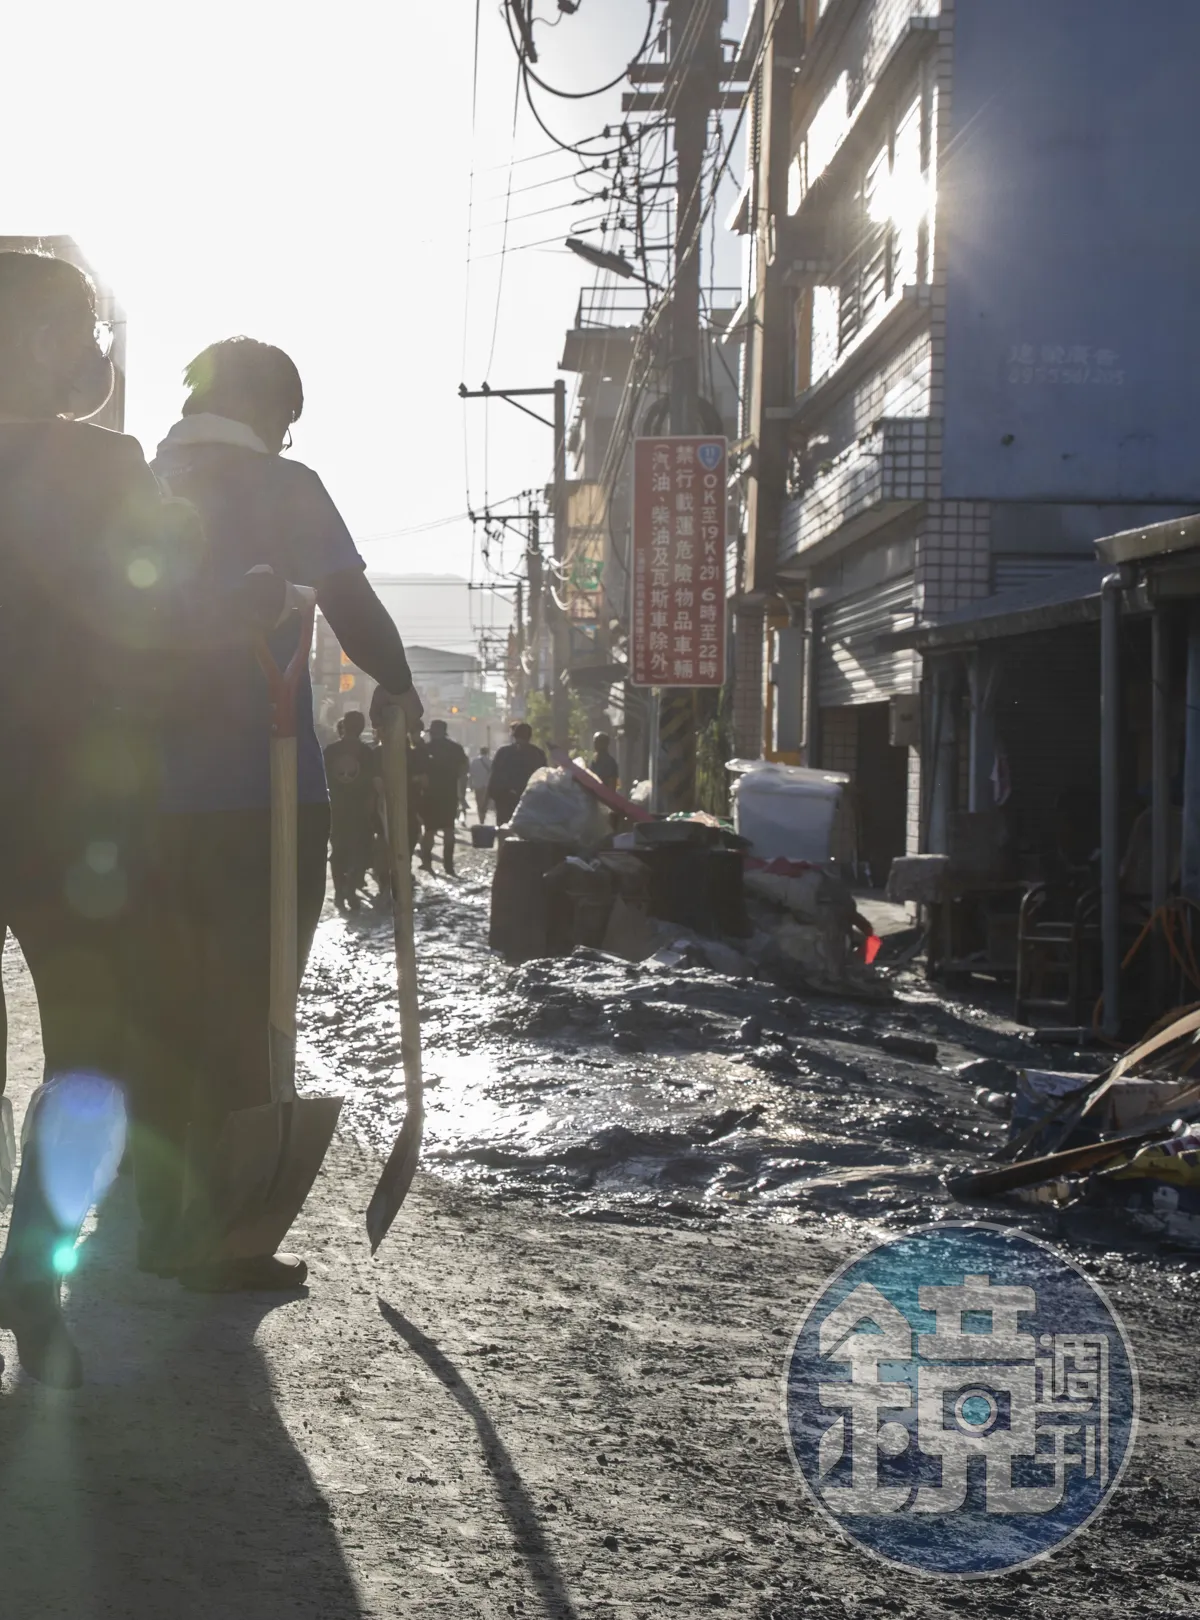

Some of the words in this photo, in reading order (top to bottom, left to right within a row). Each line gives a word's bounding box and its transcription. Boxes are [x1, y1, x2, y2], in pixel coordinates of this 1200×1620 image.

[674, 446, 695, 679] 禁行載運危險物品車輛
